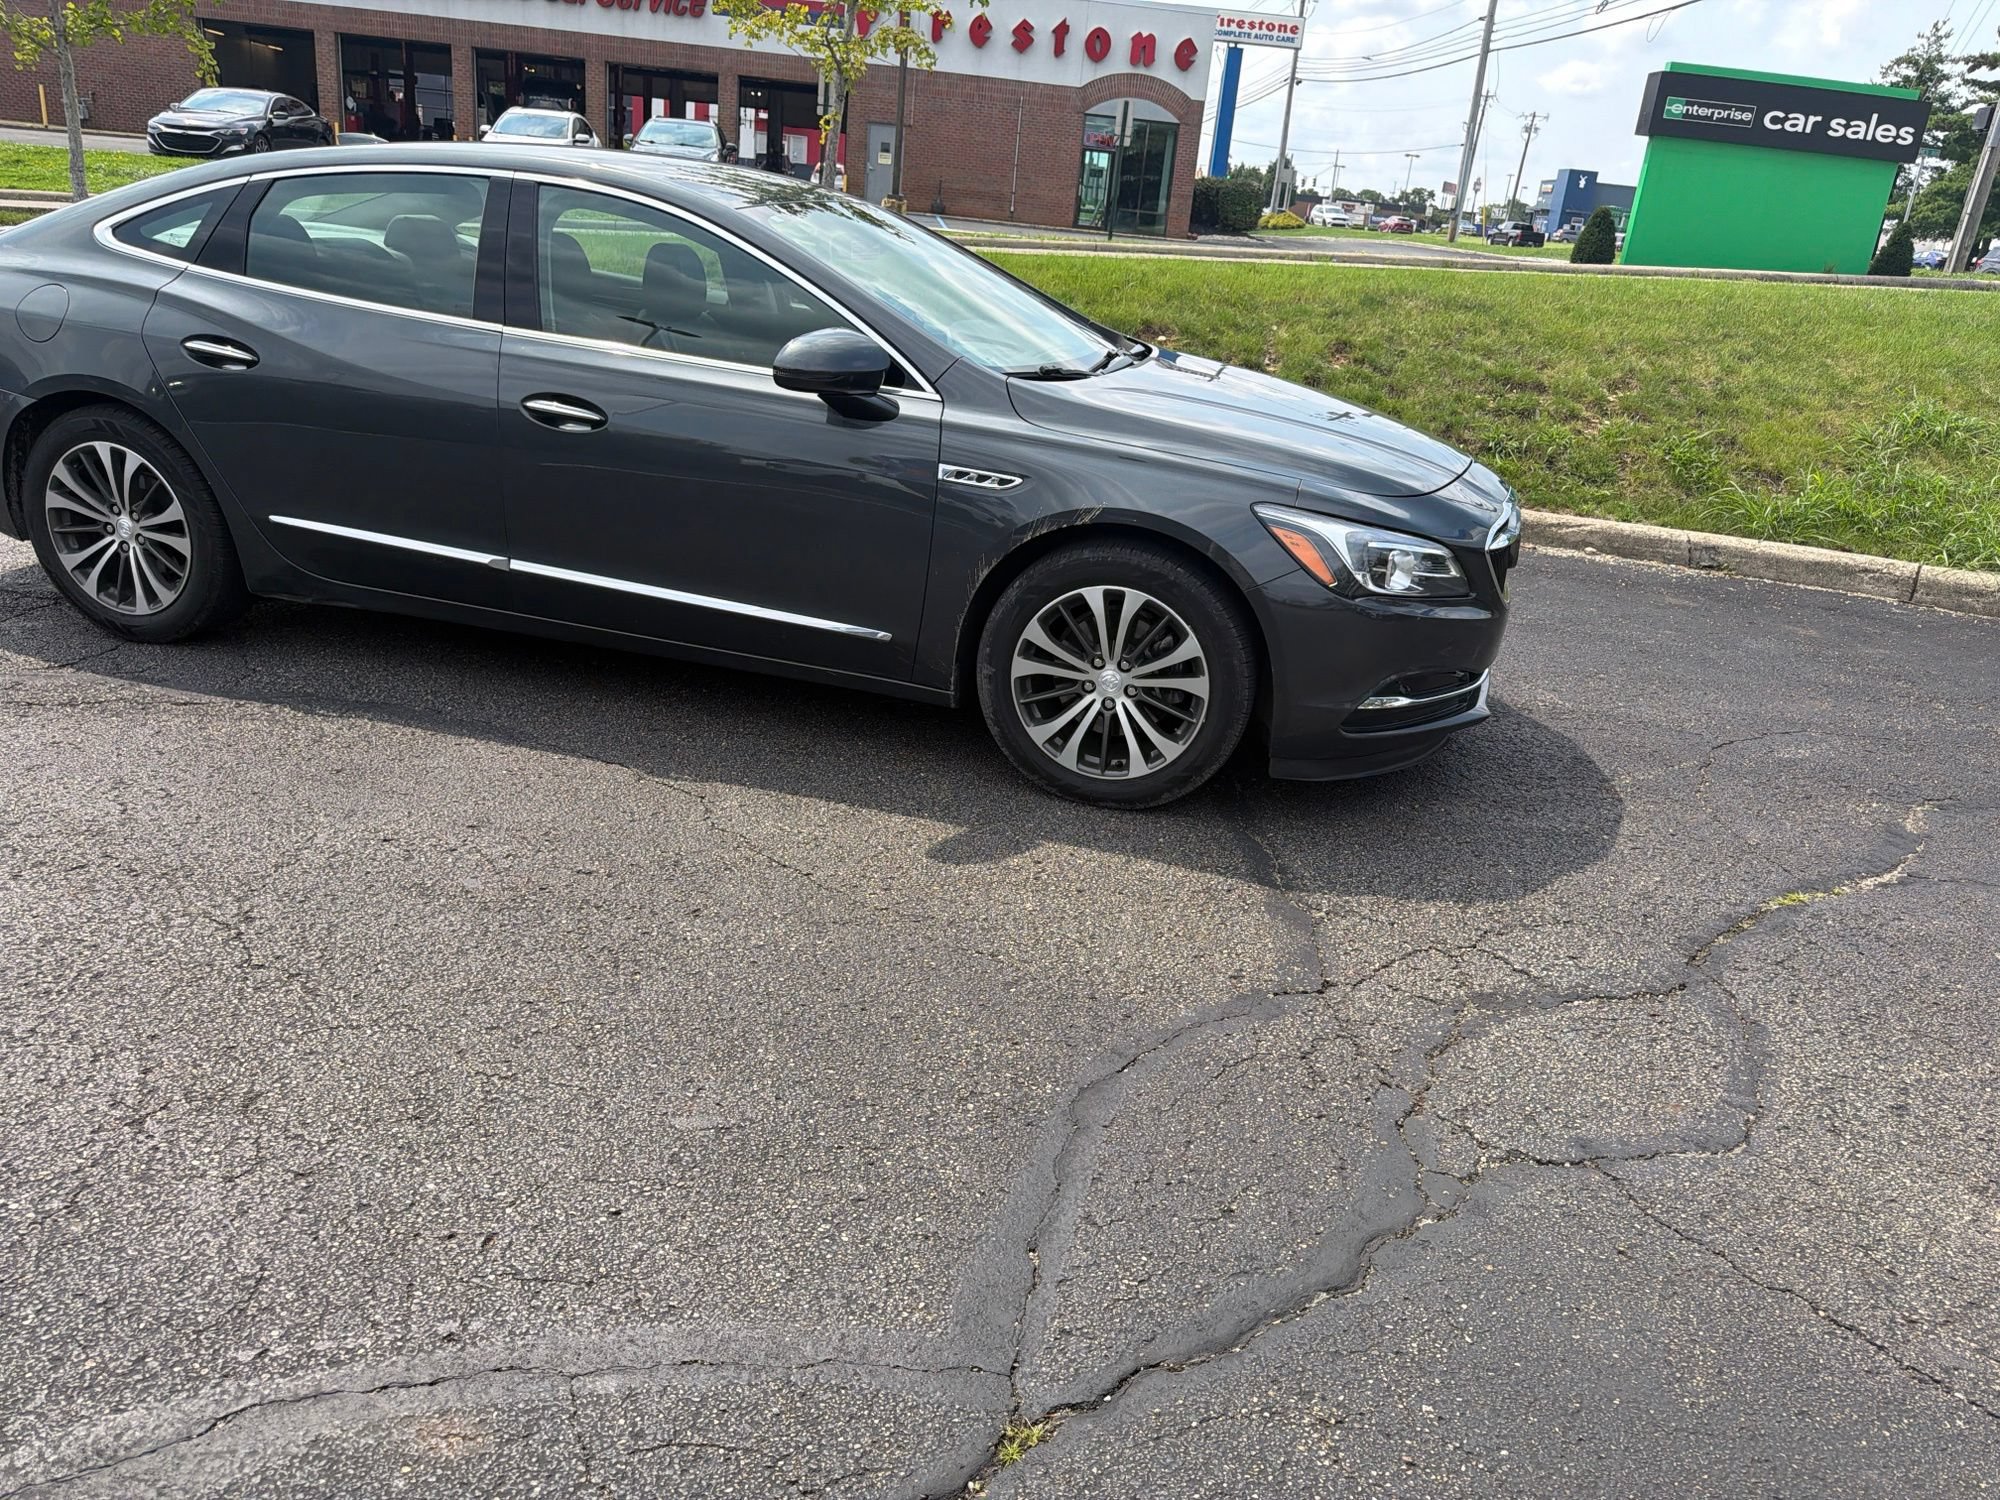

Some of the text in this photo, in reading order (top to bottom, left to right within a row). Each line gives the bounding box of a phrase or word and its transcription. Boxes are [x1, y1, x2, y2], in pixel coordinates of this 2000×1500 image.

[1216, 14, 1300, 35] irestone
[1253, 33, 1274, 42] AUTO
[1276, 35, 1296, 43] CARE
[1670, 103, 1915, 145] enterprise car sales
[1084, 132, 1115, 147] OPEN
